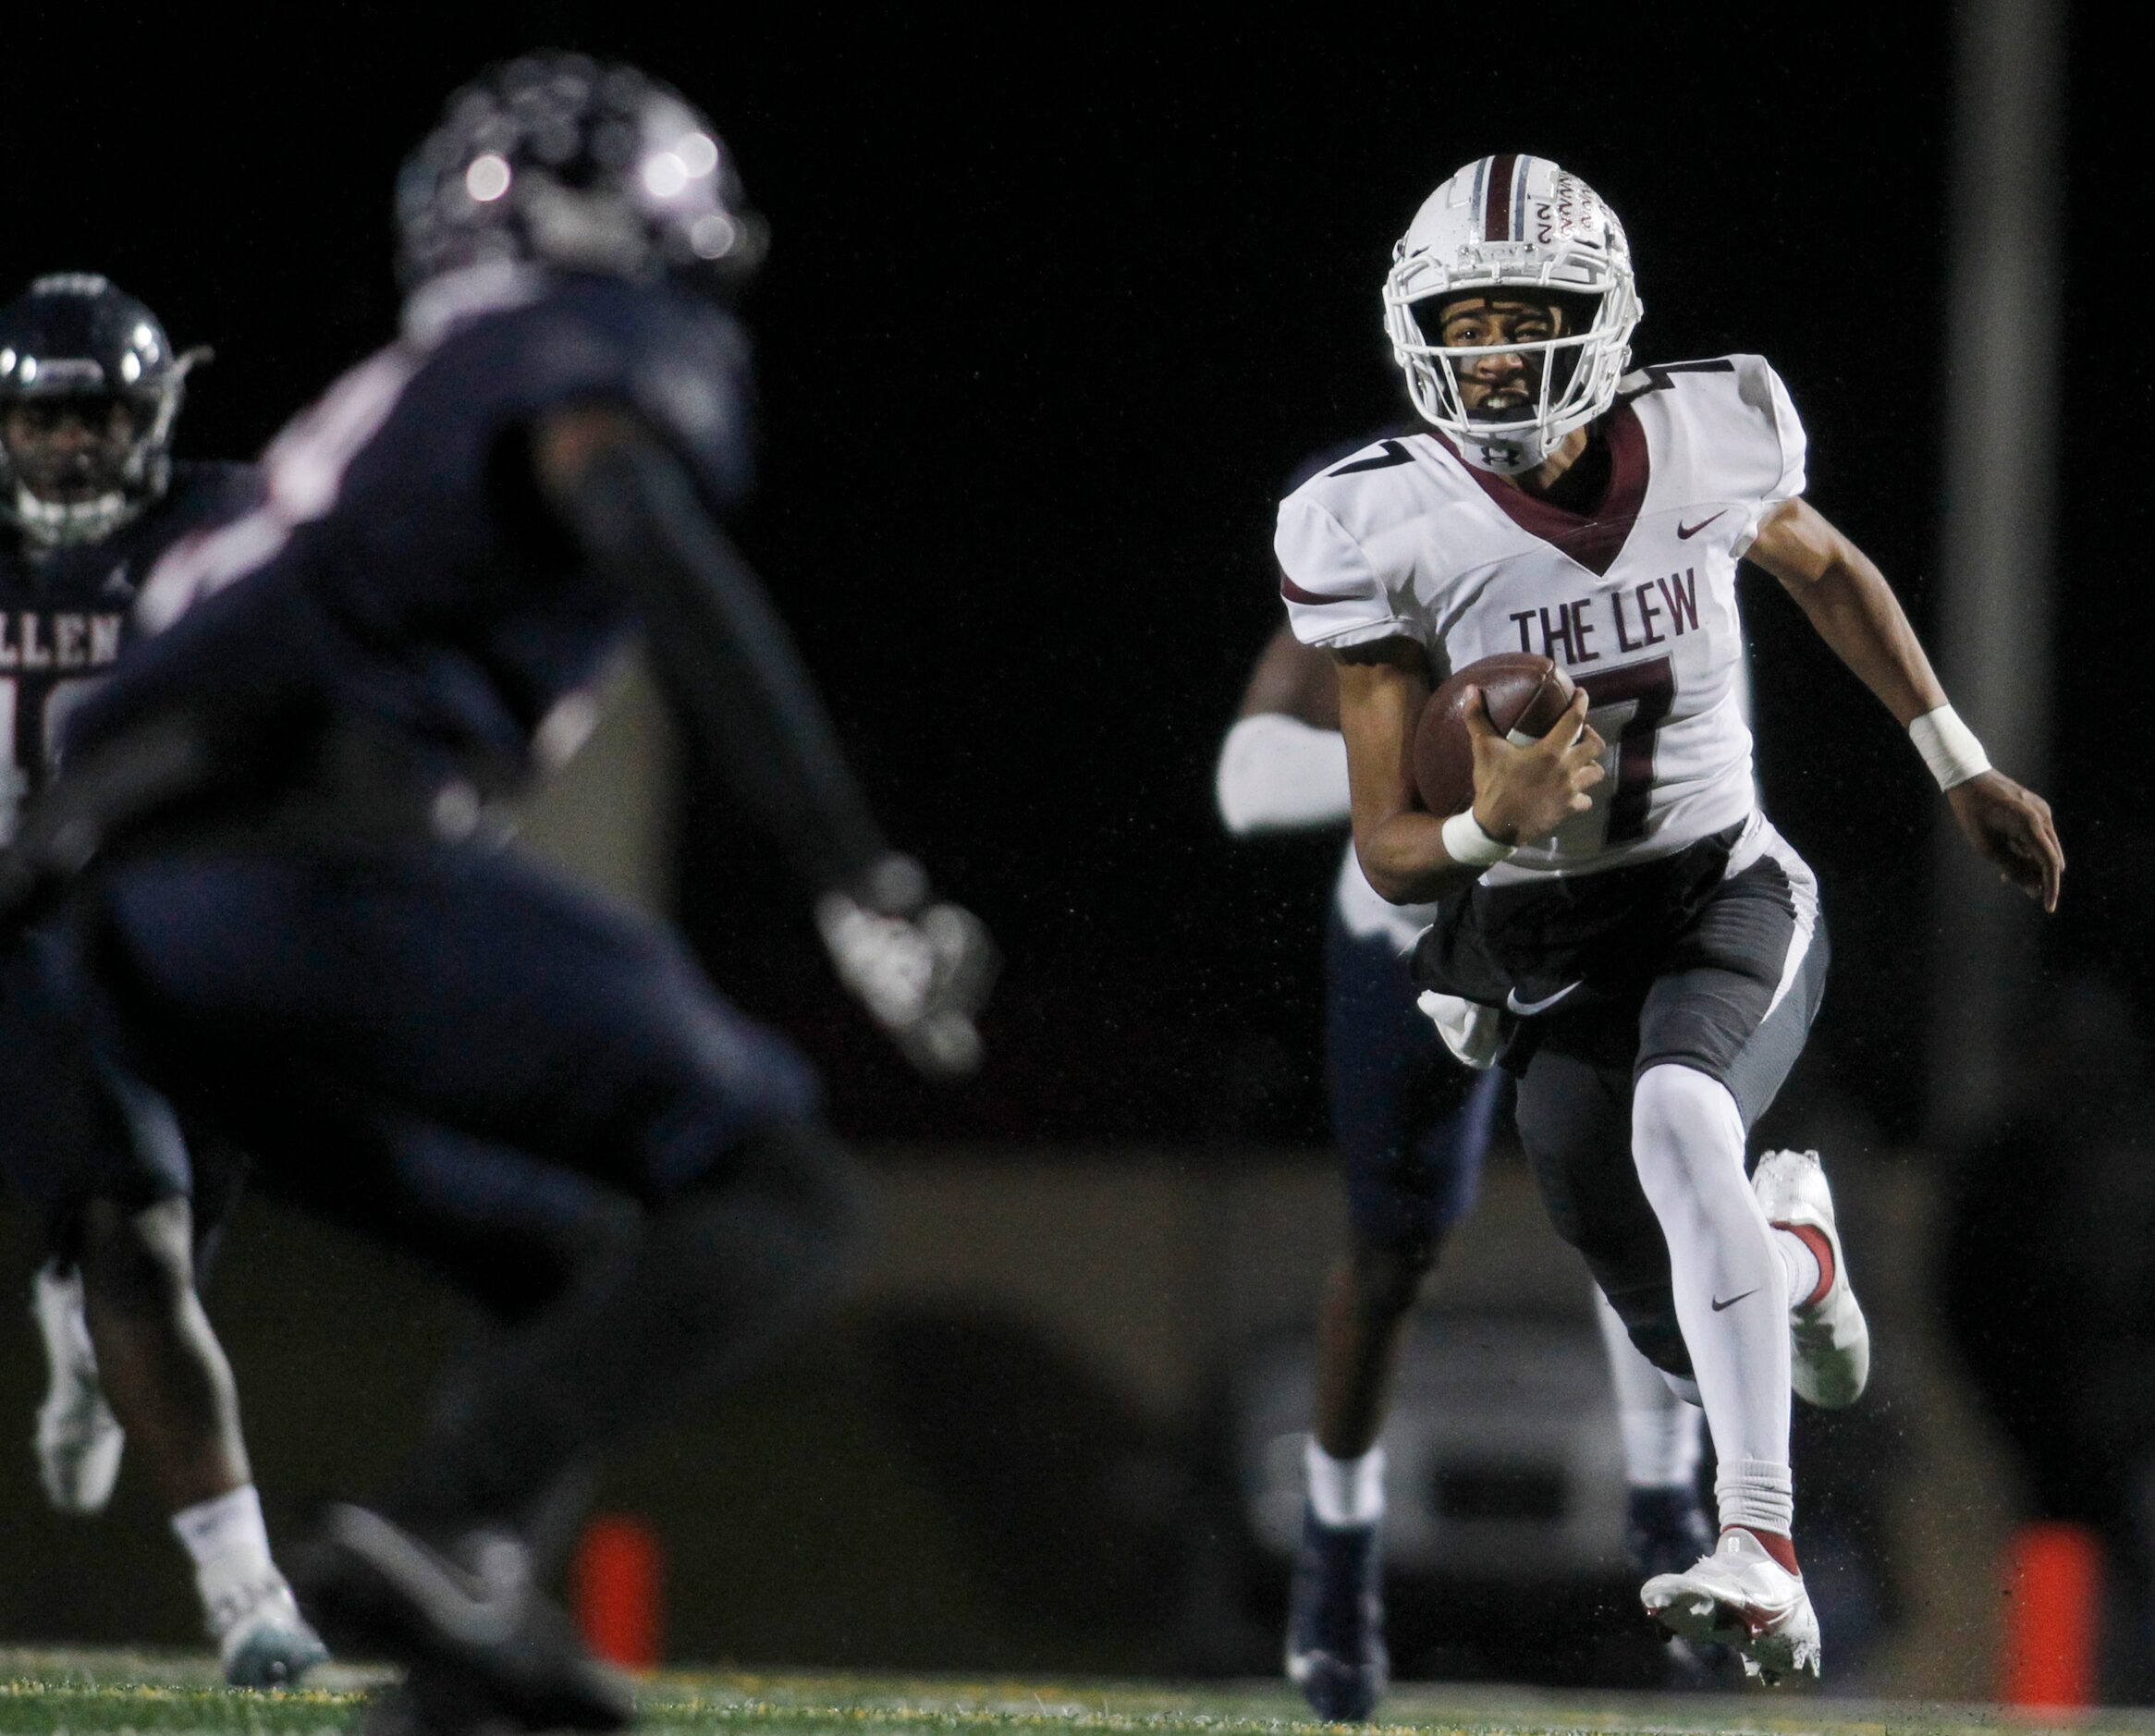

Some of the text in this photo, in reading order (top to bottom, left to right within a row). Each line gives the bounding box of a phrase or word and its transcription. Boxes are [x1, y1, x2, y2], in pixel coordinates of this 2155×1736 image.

[1509, 567, 1699, 666] THE LEW
[1570, 650, 1678, 845] 7
